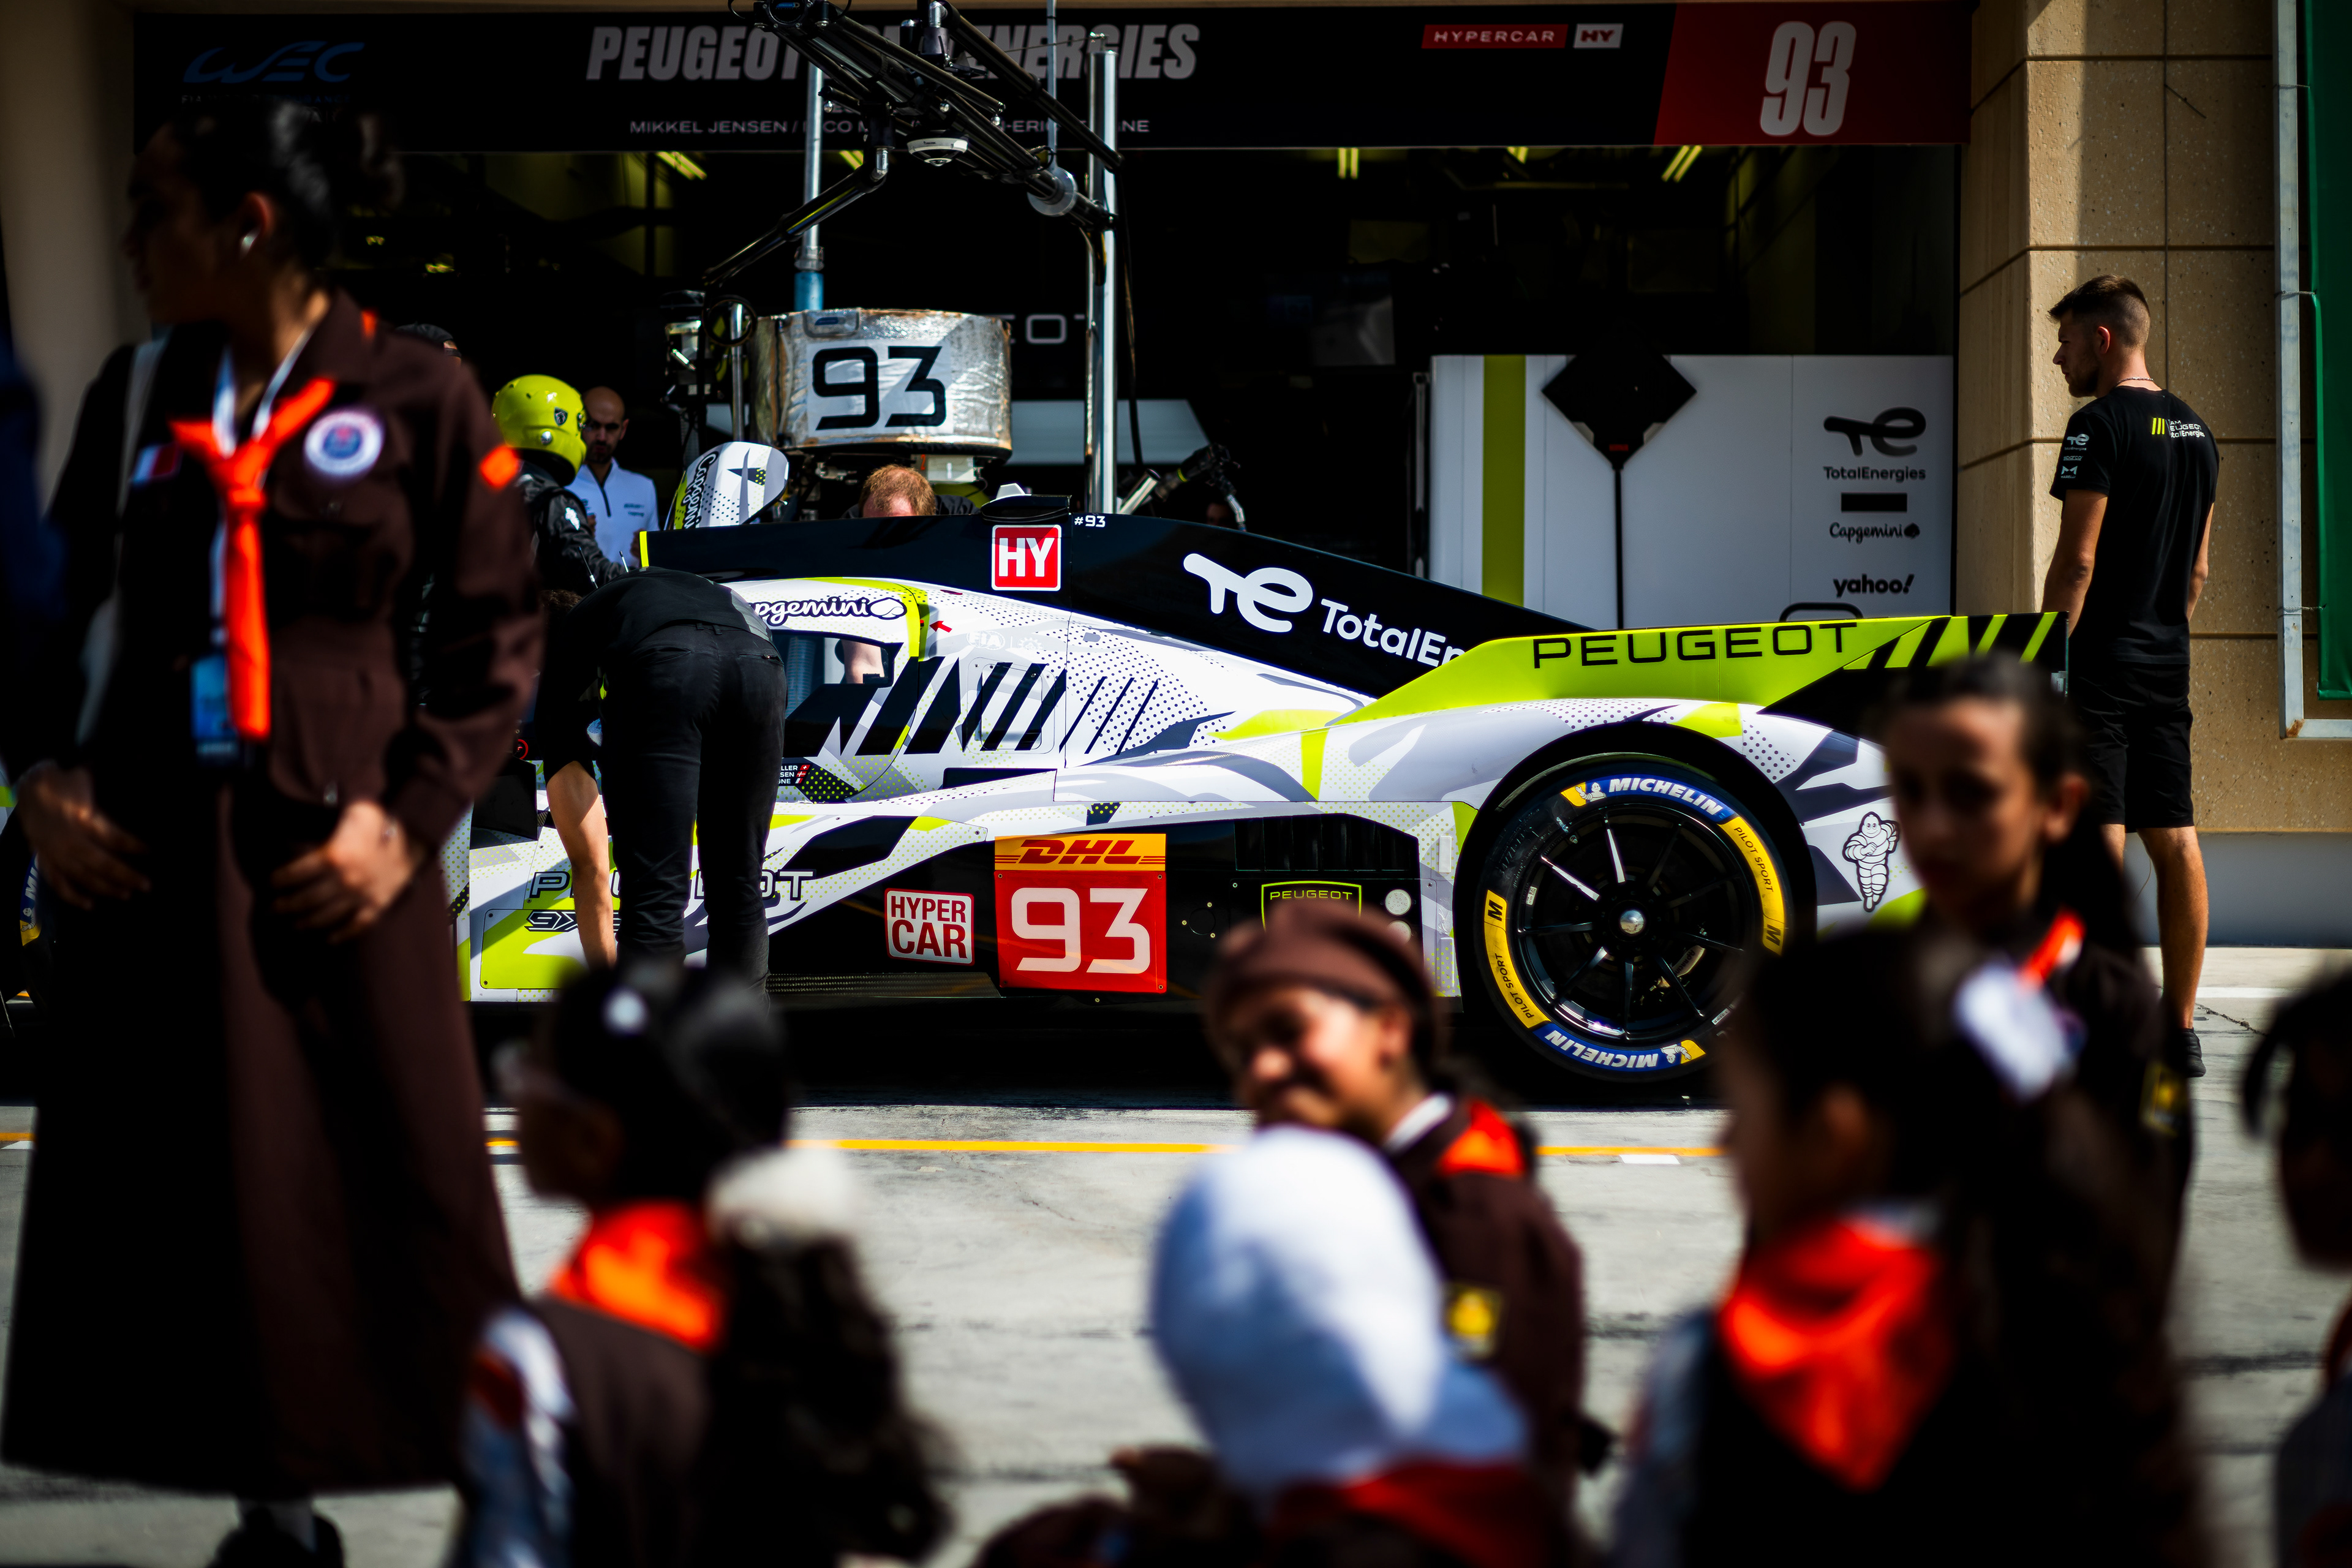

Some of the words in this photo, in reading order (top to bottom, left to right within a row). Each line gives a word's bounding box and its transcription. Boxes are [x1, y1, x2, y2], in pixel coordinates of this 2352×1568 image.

[1434, 31, 1555, 43] HYPERCAR
[1580, 29, 1615, 42] HY
[183, 40, 367, 84] WEC
[1760, 21, 1857, 136] 93
[630, 121, 703, 134] MIKKEL
[707, 121, 787, 134] JENSEN
[812, 345, 947, 431] 93
[1823, 466, 1926, 483] TotalEnergies
[1074, 515, 1106, 527] #93
[1830, 522, 1903, 545] Capgemini
[999, 538, 1055, 577] HY
[1833, 573, 1915, 598] yahoo!
[752, 597, 870, 625] pgemini
[1321, 598, 1466, 666] TotalEn
[1533, 622, 1857, 669] PEUGEOT
[1609, 778, 1723, 815] MICHELIN
[1018, 840, 1142, 864] DHL
[1734, 827, 1758, 854] PILOT
[1755, 857, 1774, 892] SPORT
[891, 895, 967, 923] HYPER
[1270, 890, 1352, 900] PEUGEOT
[1488, 899, 1503, 922] M
[892, 919, 968, 959] CAR
[1011, 888, 1150, 974] 93
[1766, 924, 1781, 946] M
[1494, 952, 1514, 989] SPORT
[1509, 987, 1535, 1019] PILOT
[1545, 1030, 1659, 1068] MICHELIN
